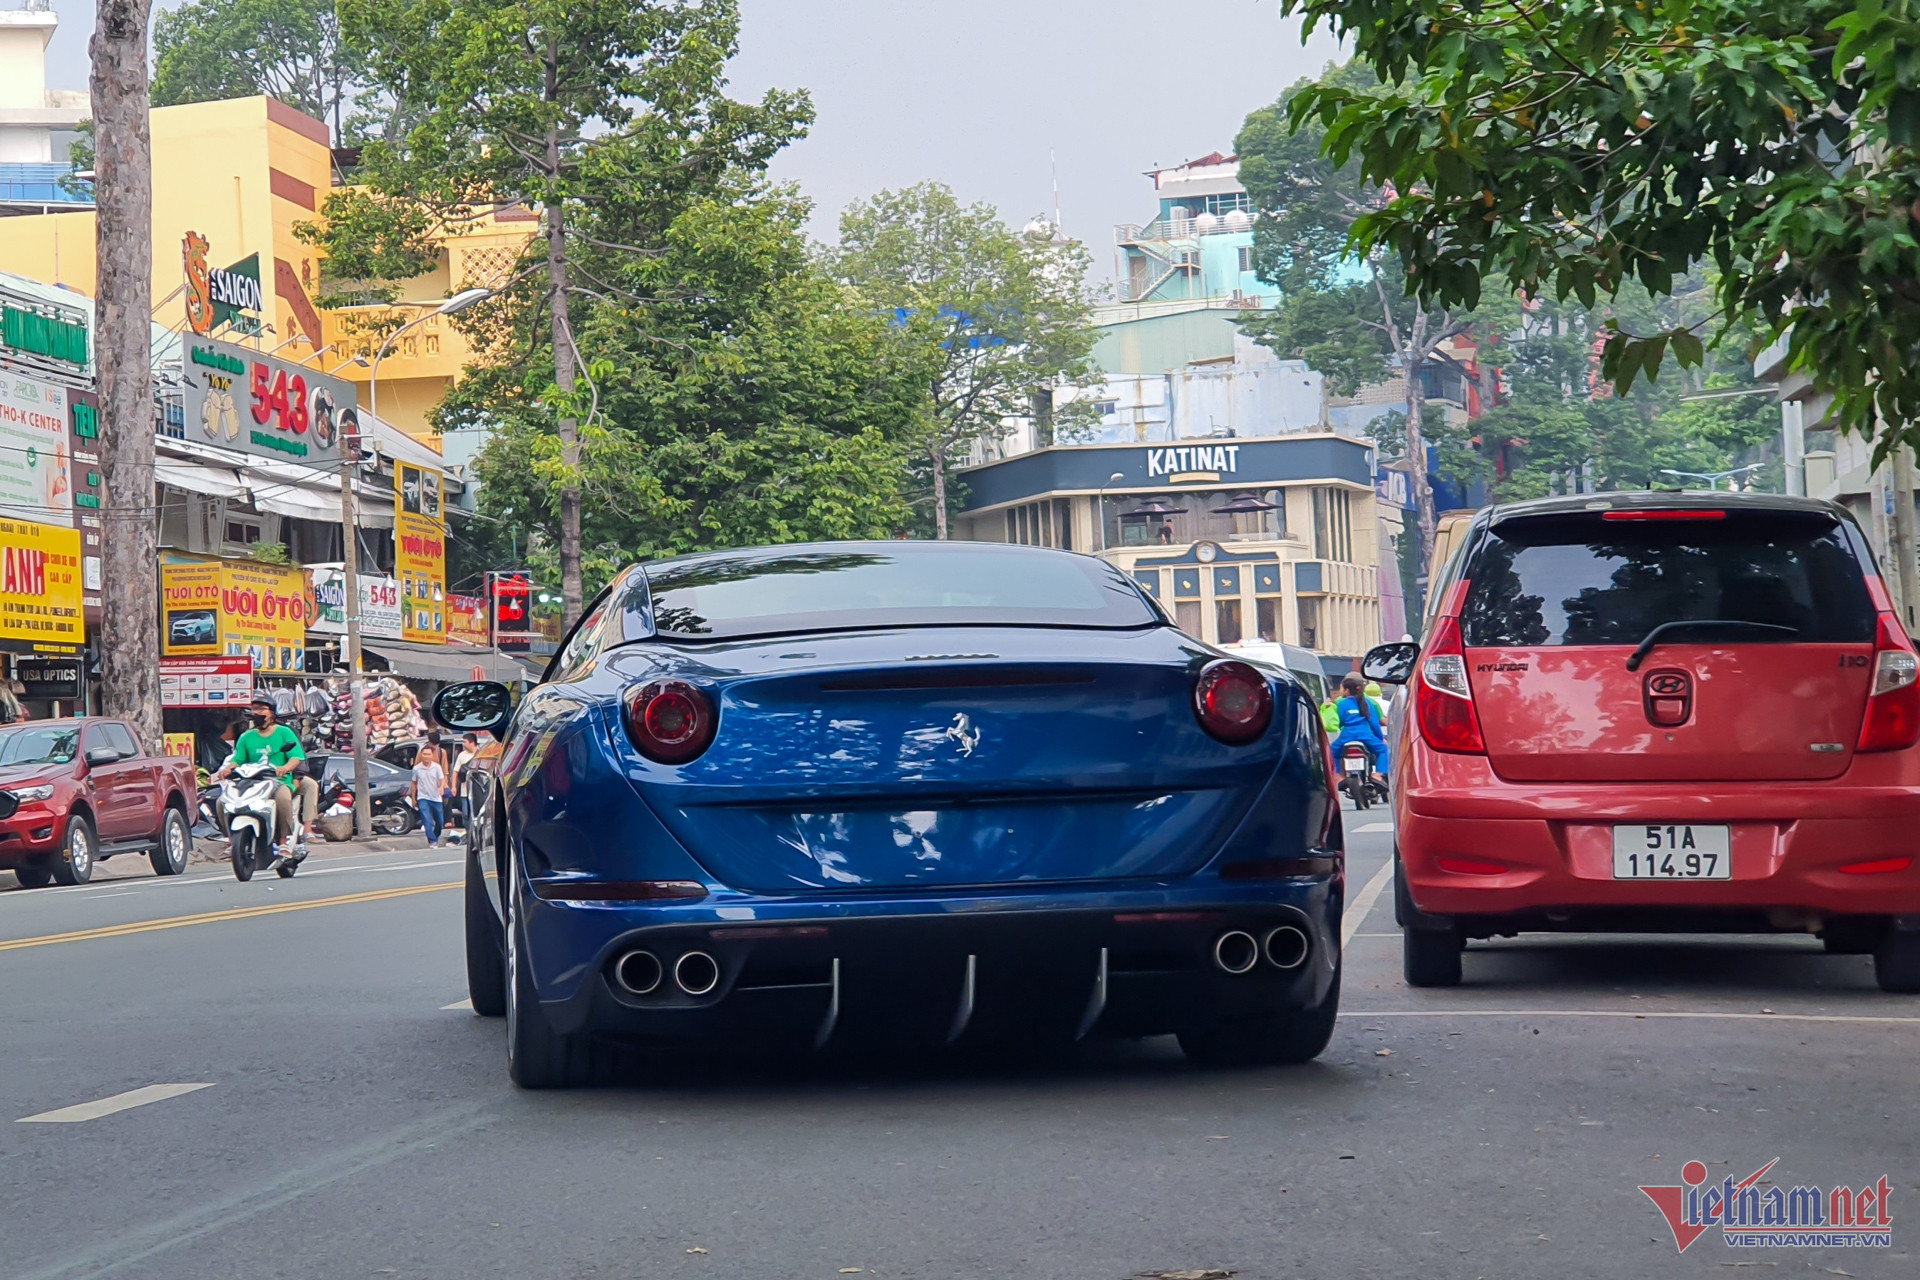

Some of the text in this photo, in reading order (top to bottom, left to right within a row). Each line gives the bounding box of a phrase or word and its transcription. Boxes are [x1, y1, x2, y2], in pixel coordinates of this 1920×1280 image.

[217, 268, 263, 311] SAIGON
[251, 362, 309, 435] 543
[29, 412, 62, 433] CENTER
[1147, 445, 1240, 477] KATINAT
[2, 547, 45, 596] ANH
[320, 583, 344, 606] SAIGON
[371, 585, 396, 606] 543
[23, 669, 76, 681] USA OPTICS
[1477, 663, 1528, 672] HYUNDAI
[1646, 826, 1696, 849] 51A
[1629, 854, 1718, 876] 114.97
